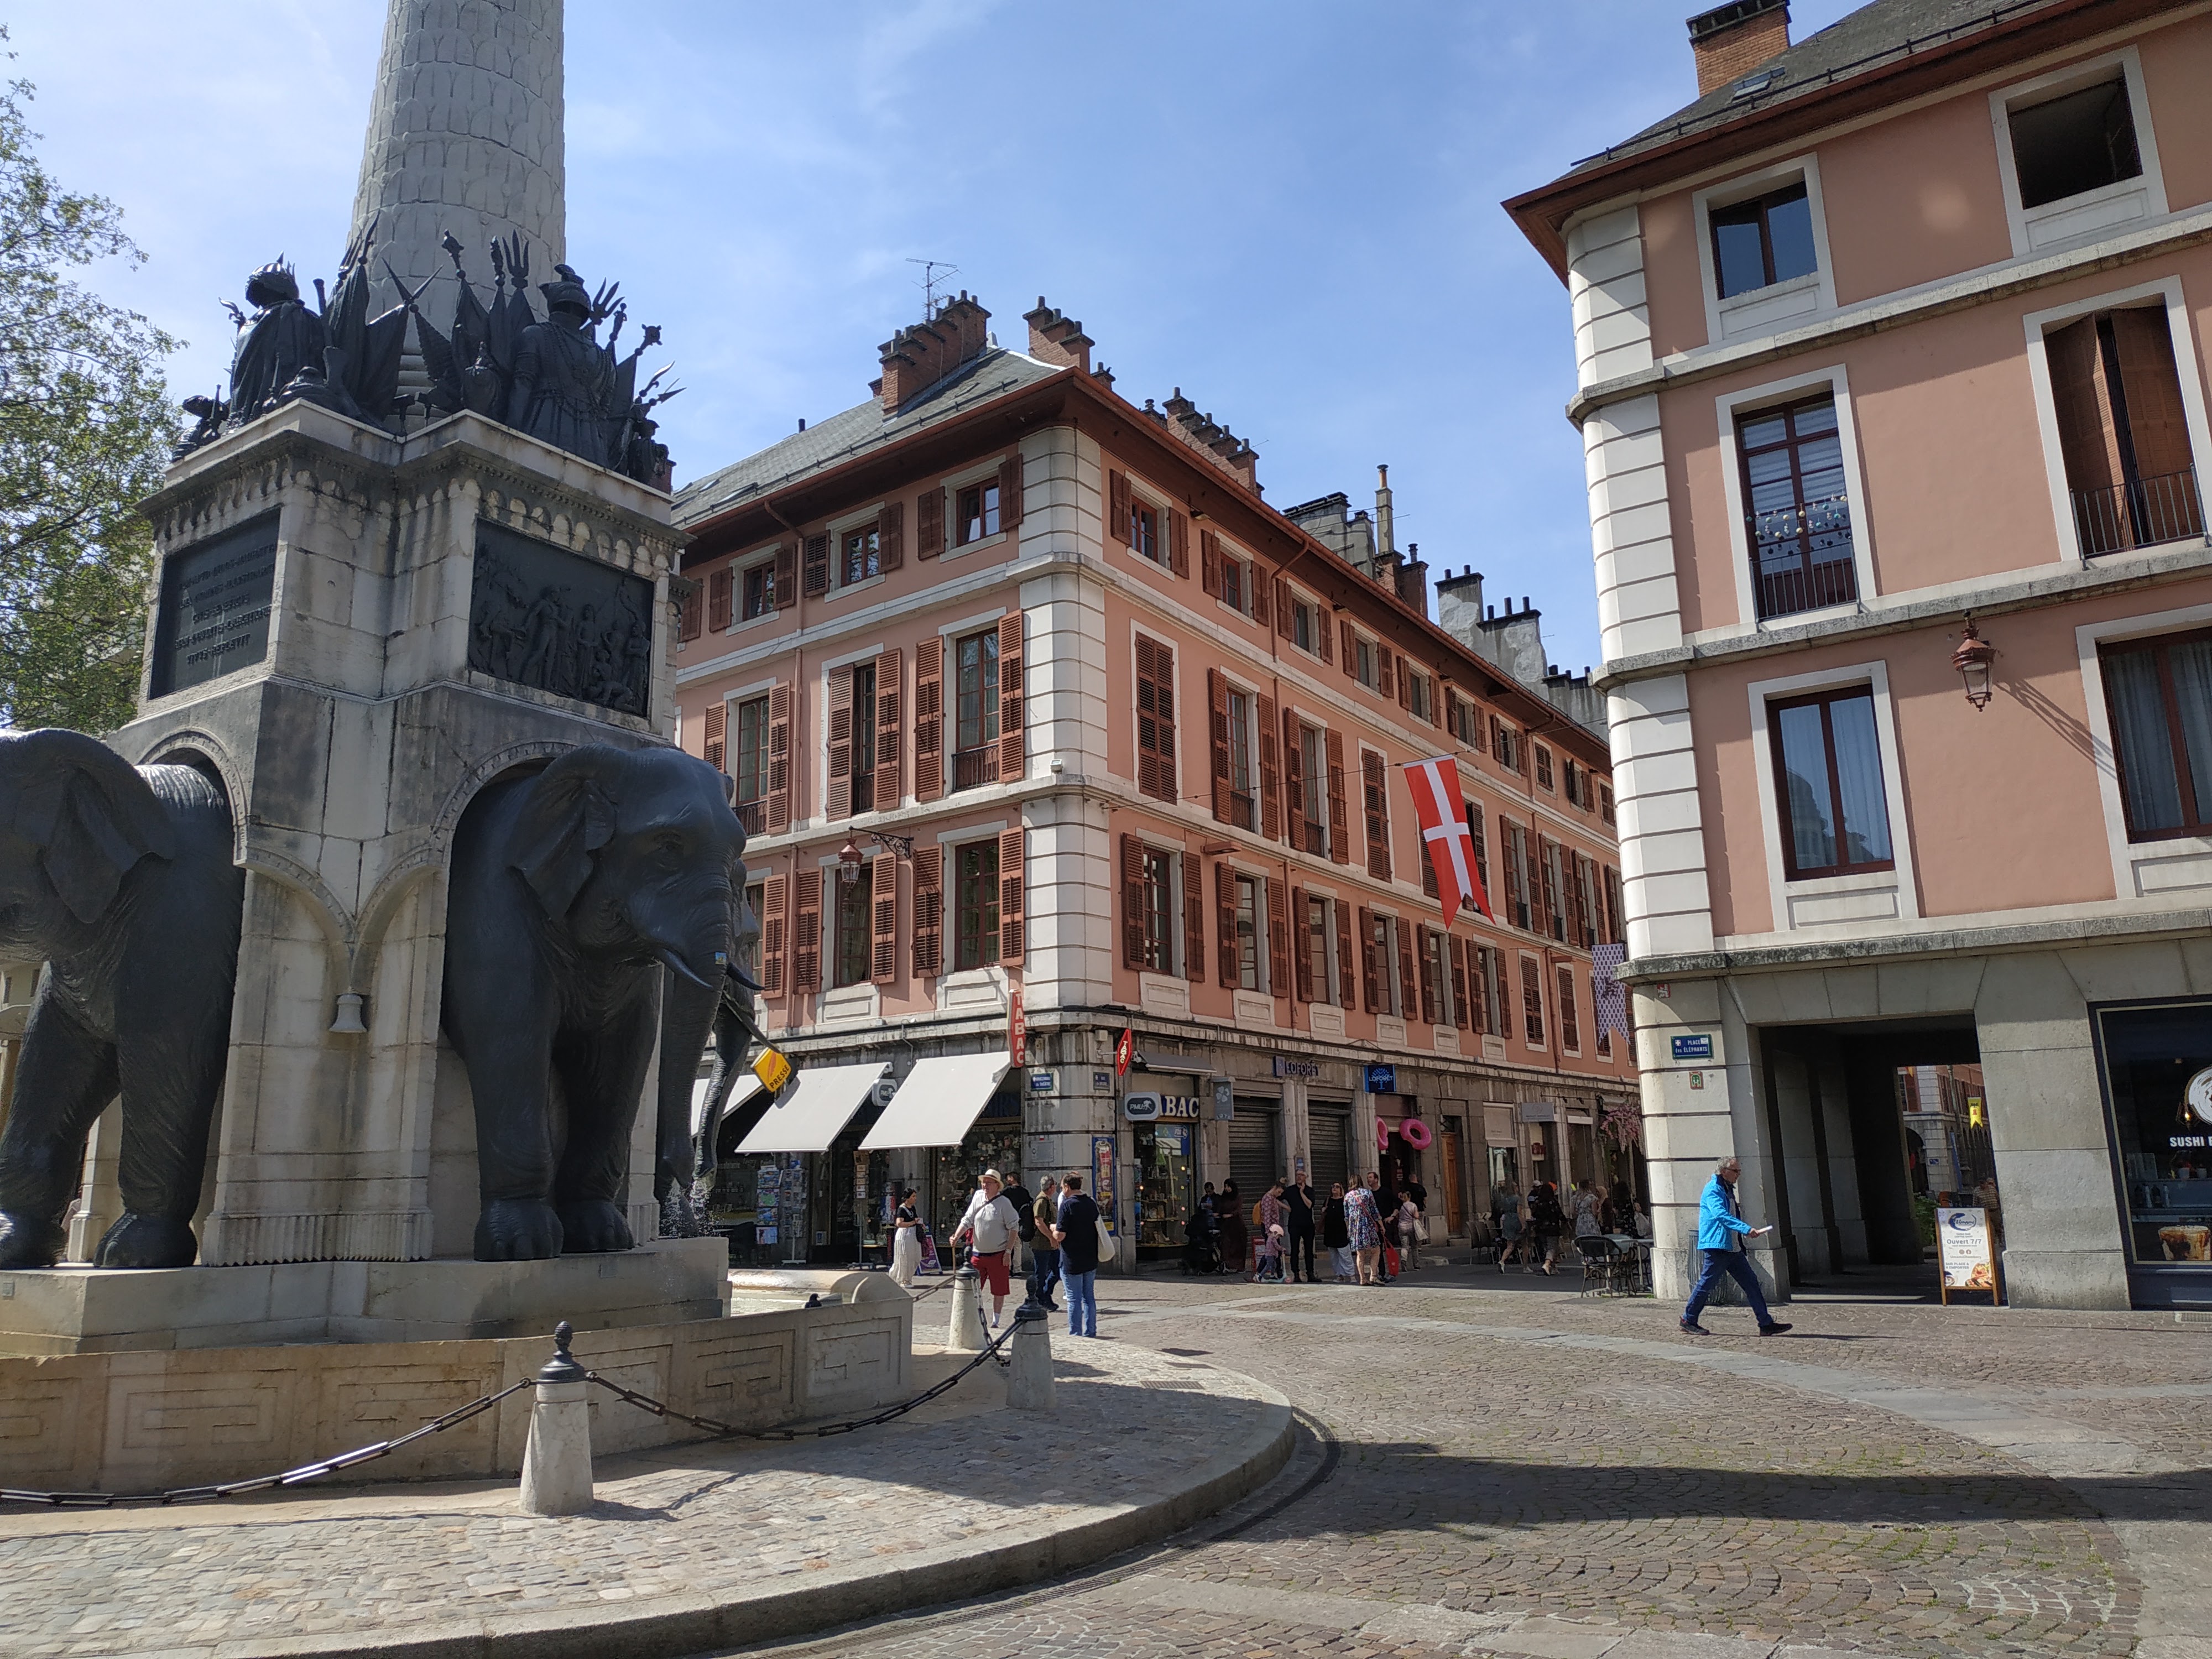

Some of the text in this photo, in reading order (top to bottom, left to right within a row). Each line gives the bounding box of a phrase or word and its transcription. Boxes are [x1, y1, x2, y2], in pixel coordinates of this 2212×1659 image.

[1014, 993, 1025, 1064] TABAC
[1120, 1040, 1129, 1064] TABAC
[769, 1064, 790, 1089] PRESSE
[2169, 1136, 2205, 1147] SUSHI
